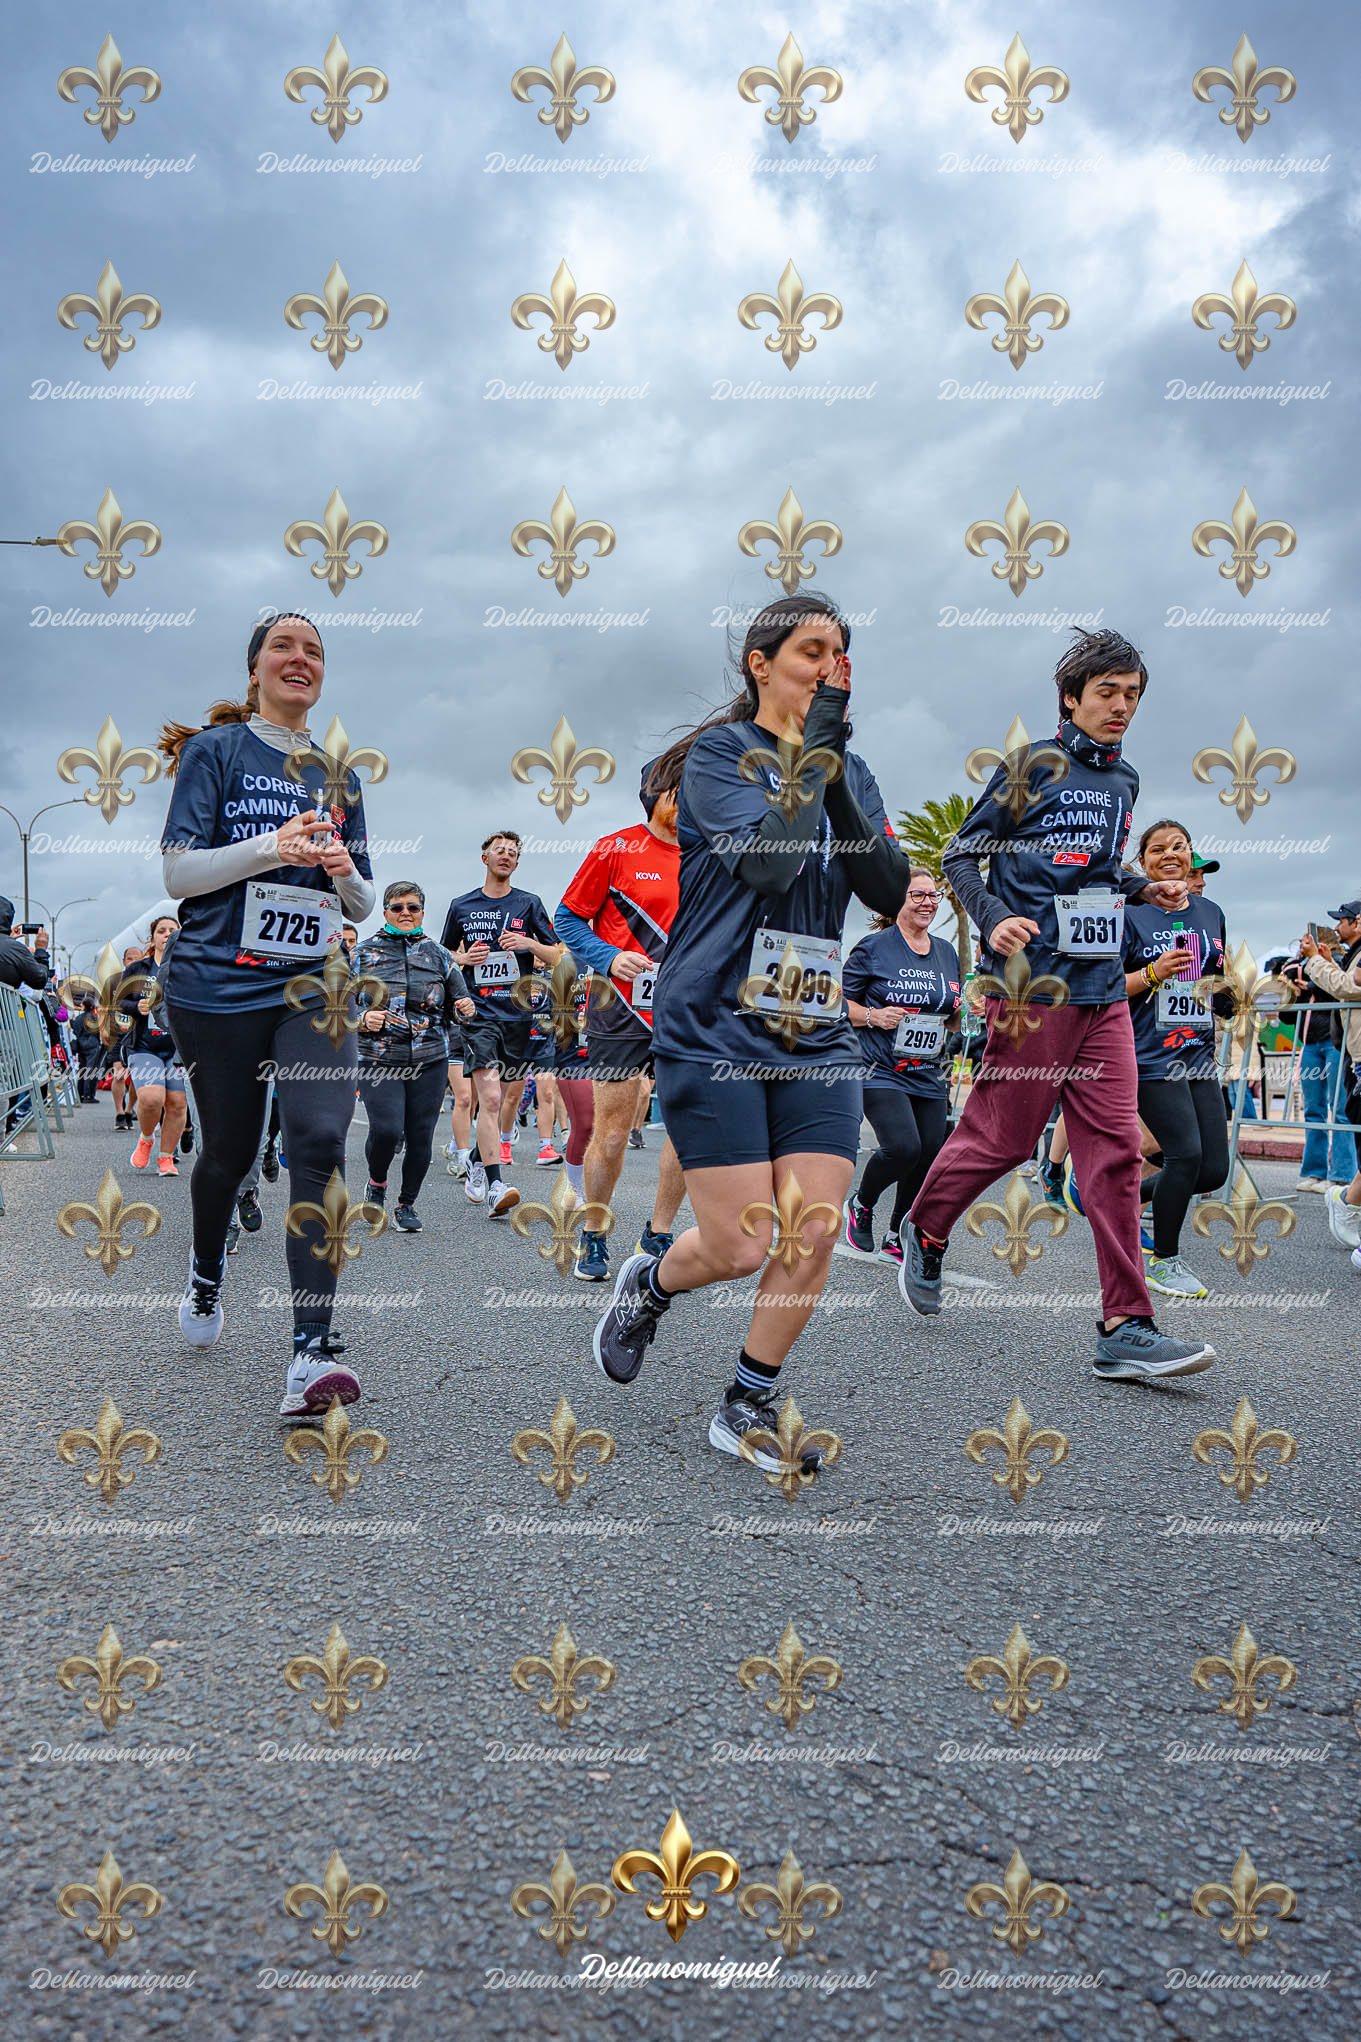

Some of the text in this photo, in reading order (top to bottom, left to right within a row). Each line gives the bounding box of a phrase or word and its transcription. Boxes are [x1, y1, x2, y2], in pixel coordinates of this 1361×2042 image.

[243, 774, 308, 798] CORRÉ
[225, 797, 300, 818] CAMINÁ
[1059, 790, 1112, 808] CORRÉ
[1041, 809, 1108, 828] CAMINÁ
[1042, 829, 1102, 848] AYUDÁ
[635, 871, 662, 881] KOVA
[470, 910, 501, 920] CORRÉ
[258, 909, 320, 947] 2725
[462, 921, 498, 932] CAMINÁ
[1070, 916, 1117, 944] 2631
[467, 931, 493, 942] AYUDÁ
[480, 963, 509, 979] 2724
[898, 968, 937, 981] CORRÉ
[762, 962, 831, 1005] 2999
[887, 980, 936, 992] CAMINÁ
[885, 992, 931, 1005] AYUDÁ
[904, 1029, 938, 1050] 2979
